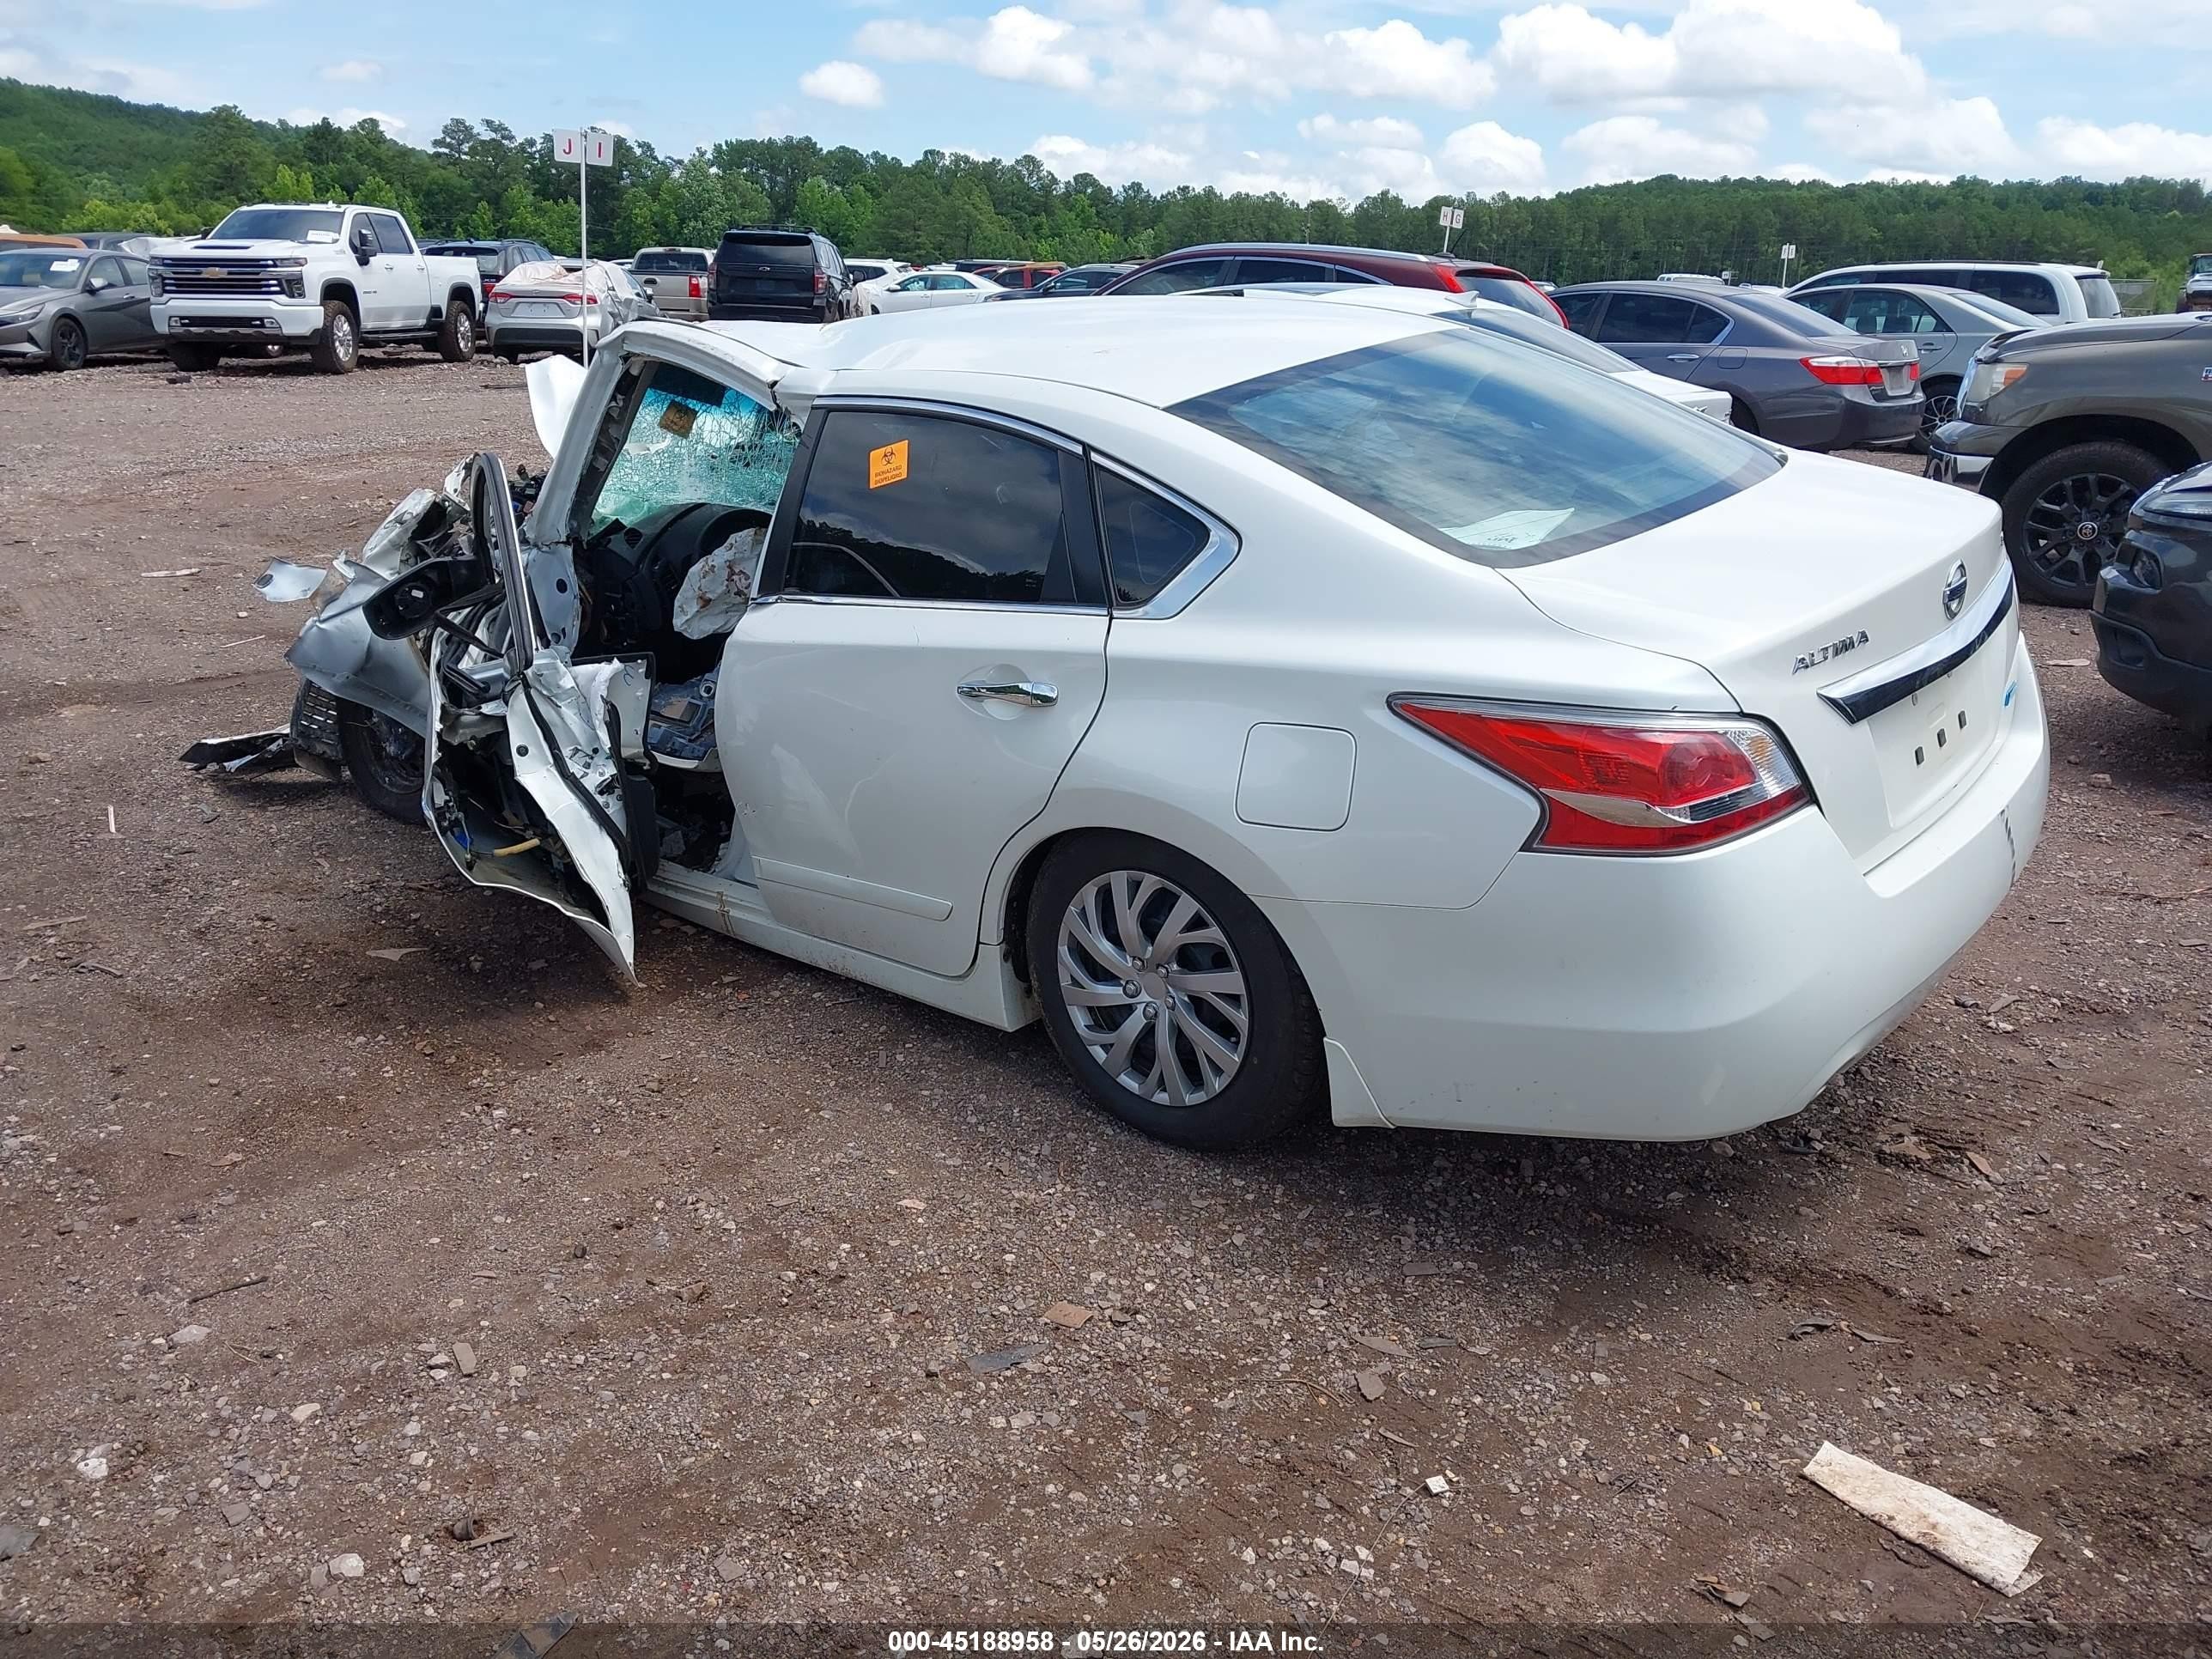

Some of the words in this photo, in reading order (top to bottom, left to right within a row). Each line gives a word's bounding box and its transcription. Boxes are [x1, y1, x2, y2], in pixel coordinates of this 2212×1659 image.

[562, 138, 572, 155] J
[598, 142, 603, 159] I
[874, 465, 902, 478] BIOHAZARD
[874, 471, 902, 485] BIOPELIGRO
[1791, 629, 1870, 675] ALTIMA
